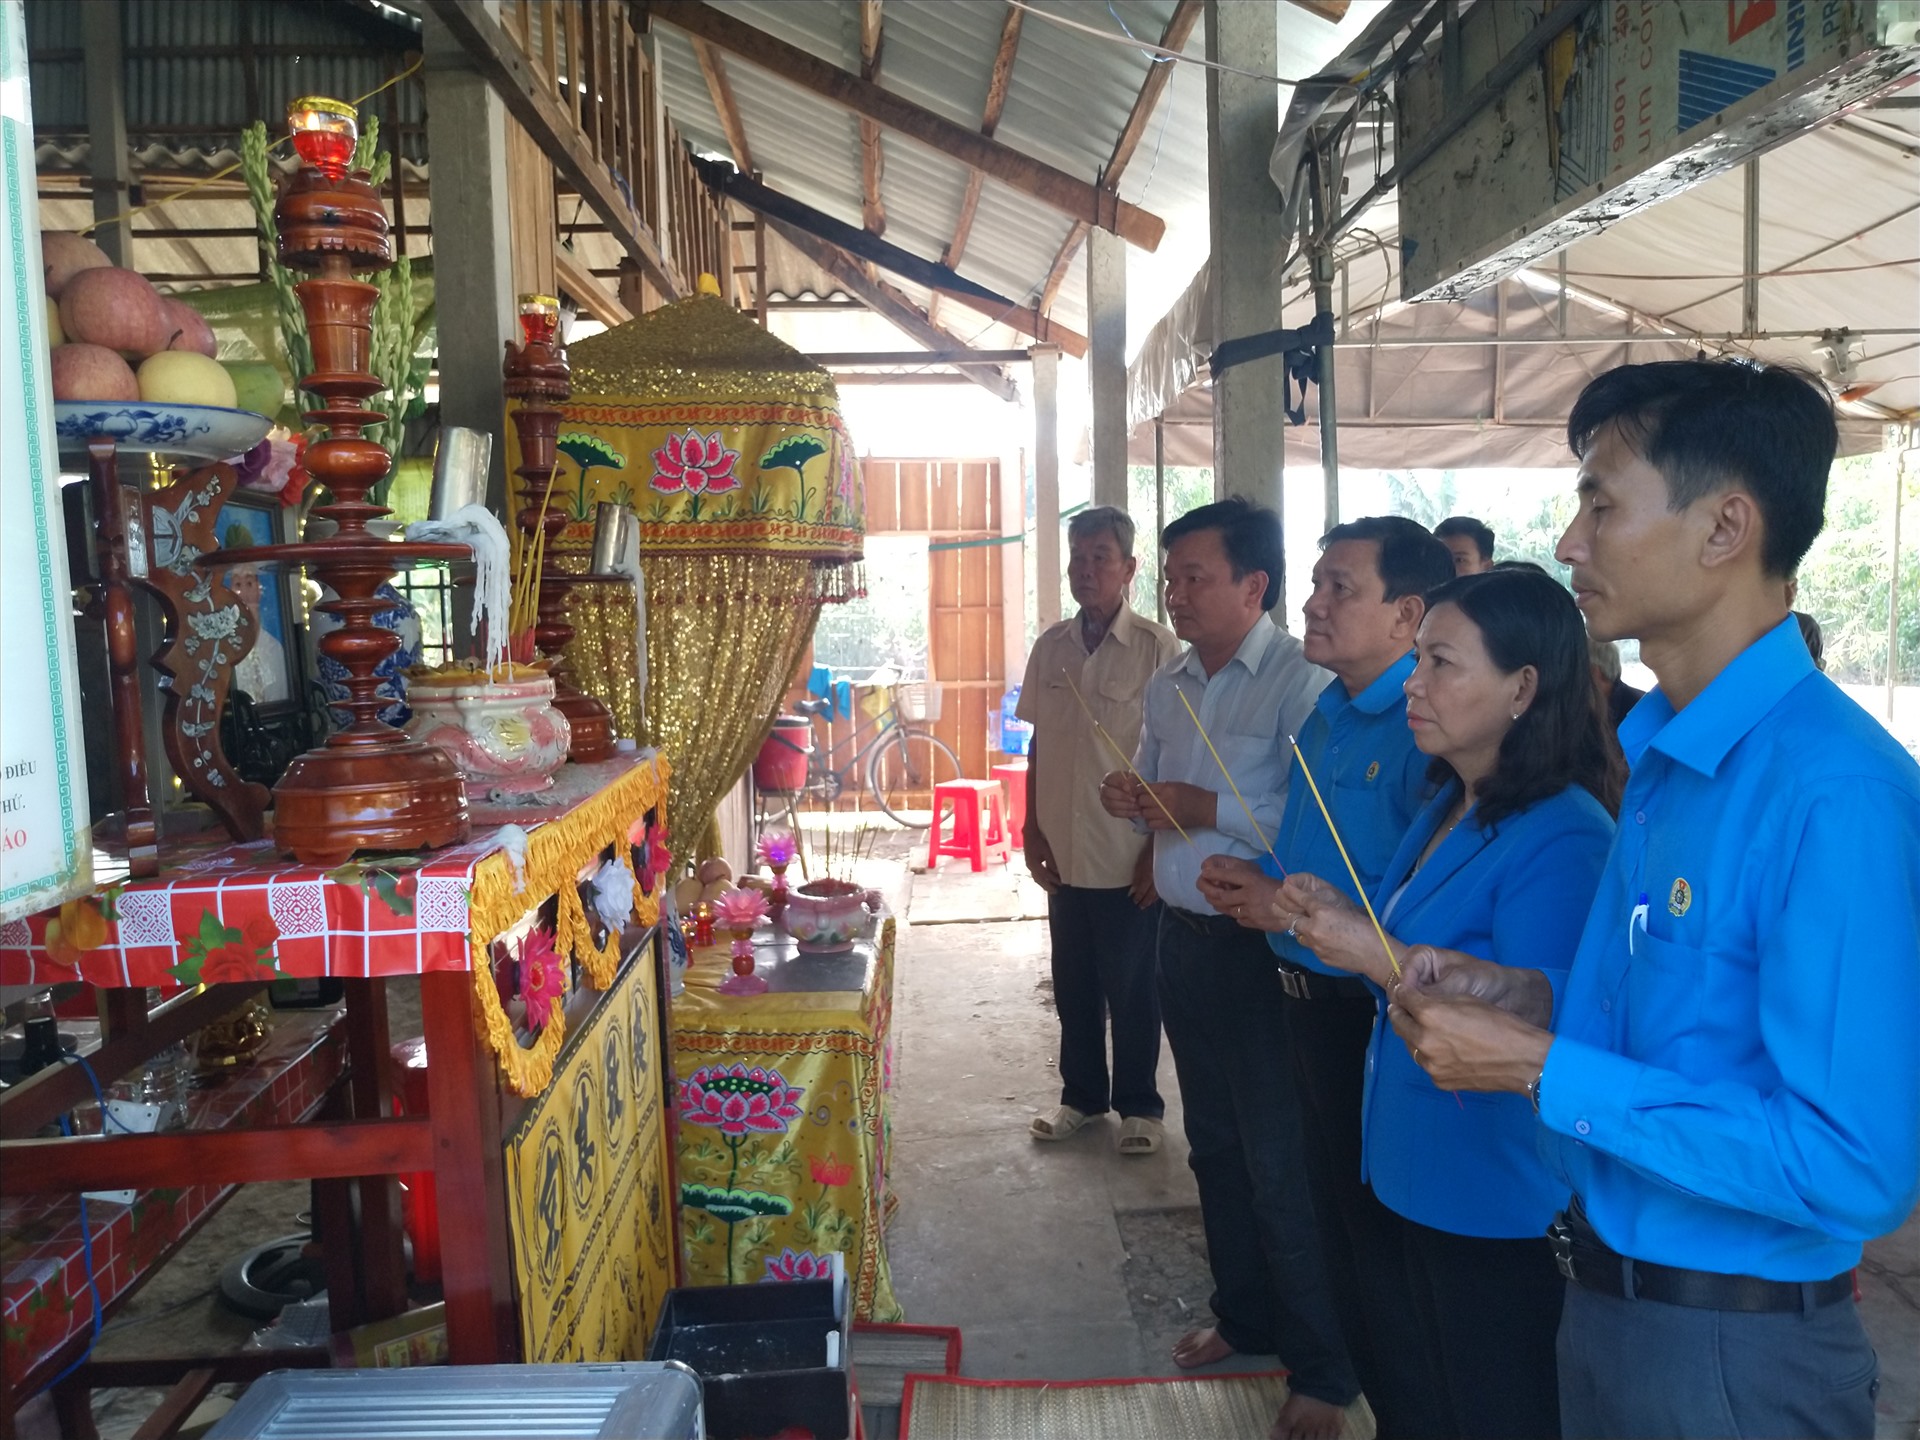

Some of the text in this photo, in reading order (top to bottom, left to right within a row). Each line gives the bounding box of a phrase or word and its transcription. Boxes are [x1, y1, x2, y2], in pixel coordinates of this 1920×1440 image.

[1612, 76, 1627, 153] 9001
[0, 792, 26, 814] HỨ.
[0, 827, 27, 853] ÁO
